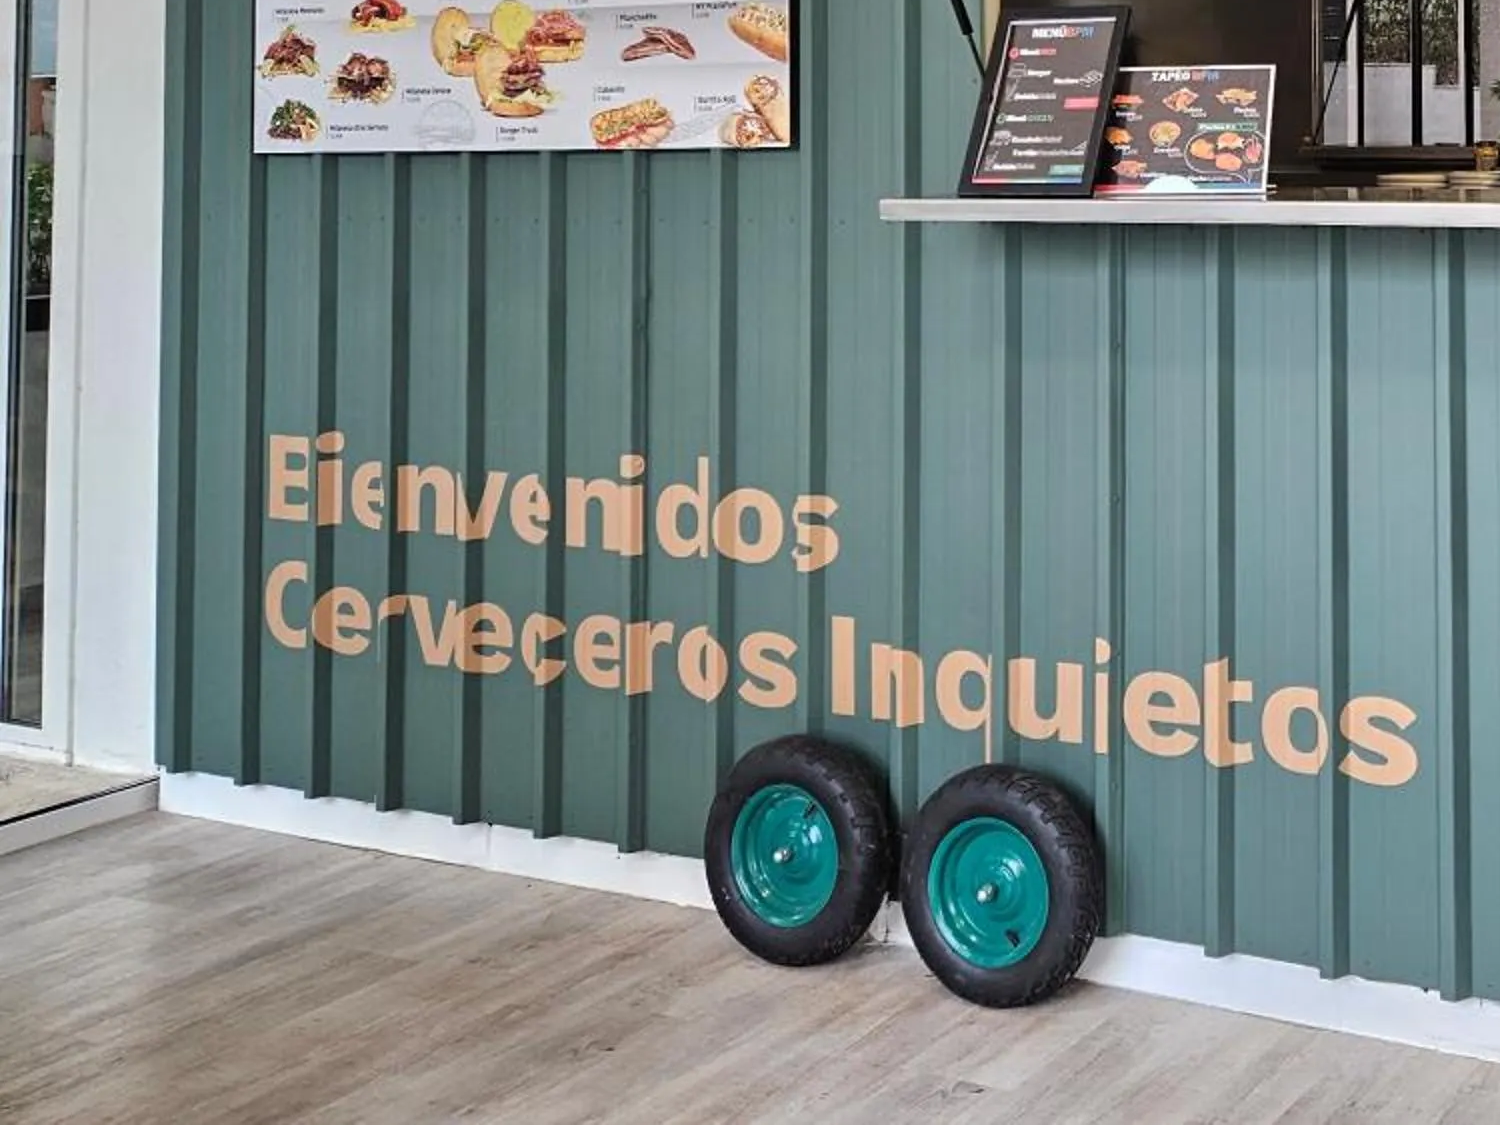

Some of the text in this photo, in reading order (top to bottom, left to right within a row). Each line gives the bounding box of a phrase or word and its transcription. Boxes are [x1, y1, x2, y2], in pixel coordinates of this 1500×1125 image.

[267, 430, 841, 573] Bienvenidos
[264, 560, 1418, 787] Cerveceros Inquietos
